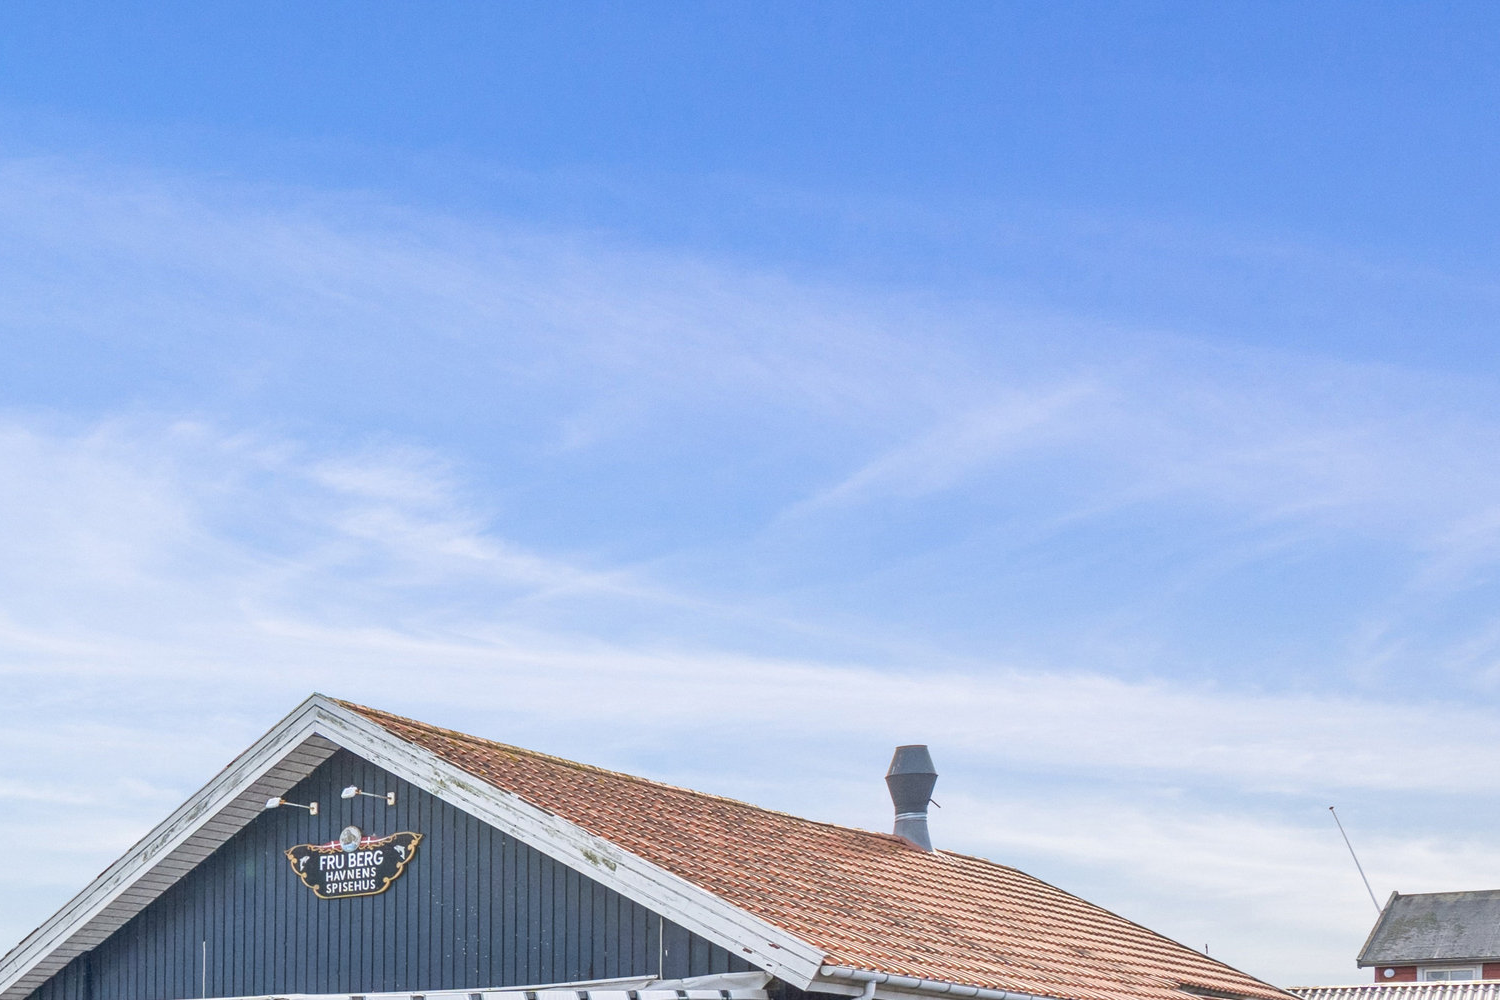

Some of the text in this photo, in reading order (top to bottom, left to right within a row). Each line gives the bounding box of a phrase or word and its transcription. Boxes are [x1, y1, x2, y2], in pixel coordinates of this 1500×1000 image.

[320, 850, 384, 871] FRU BERG
[326, 867, 376, 882] HAVNENS
[326, 879, 376, 894] SPISEHUS
